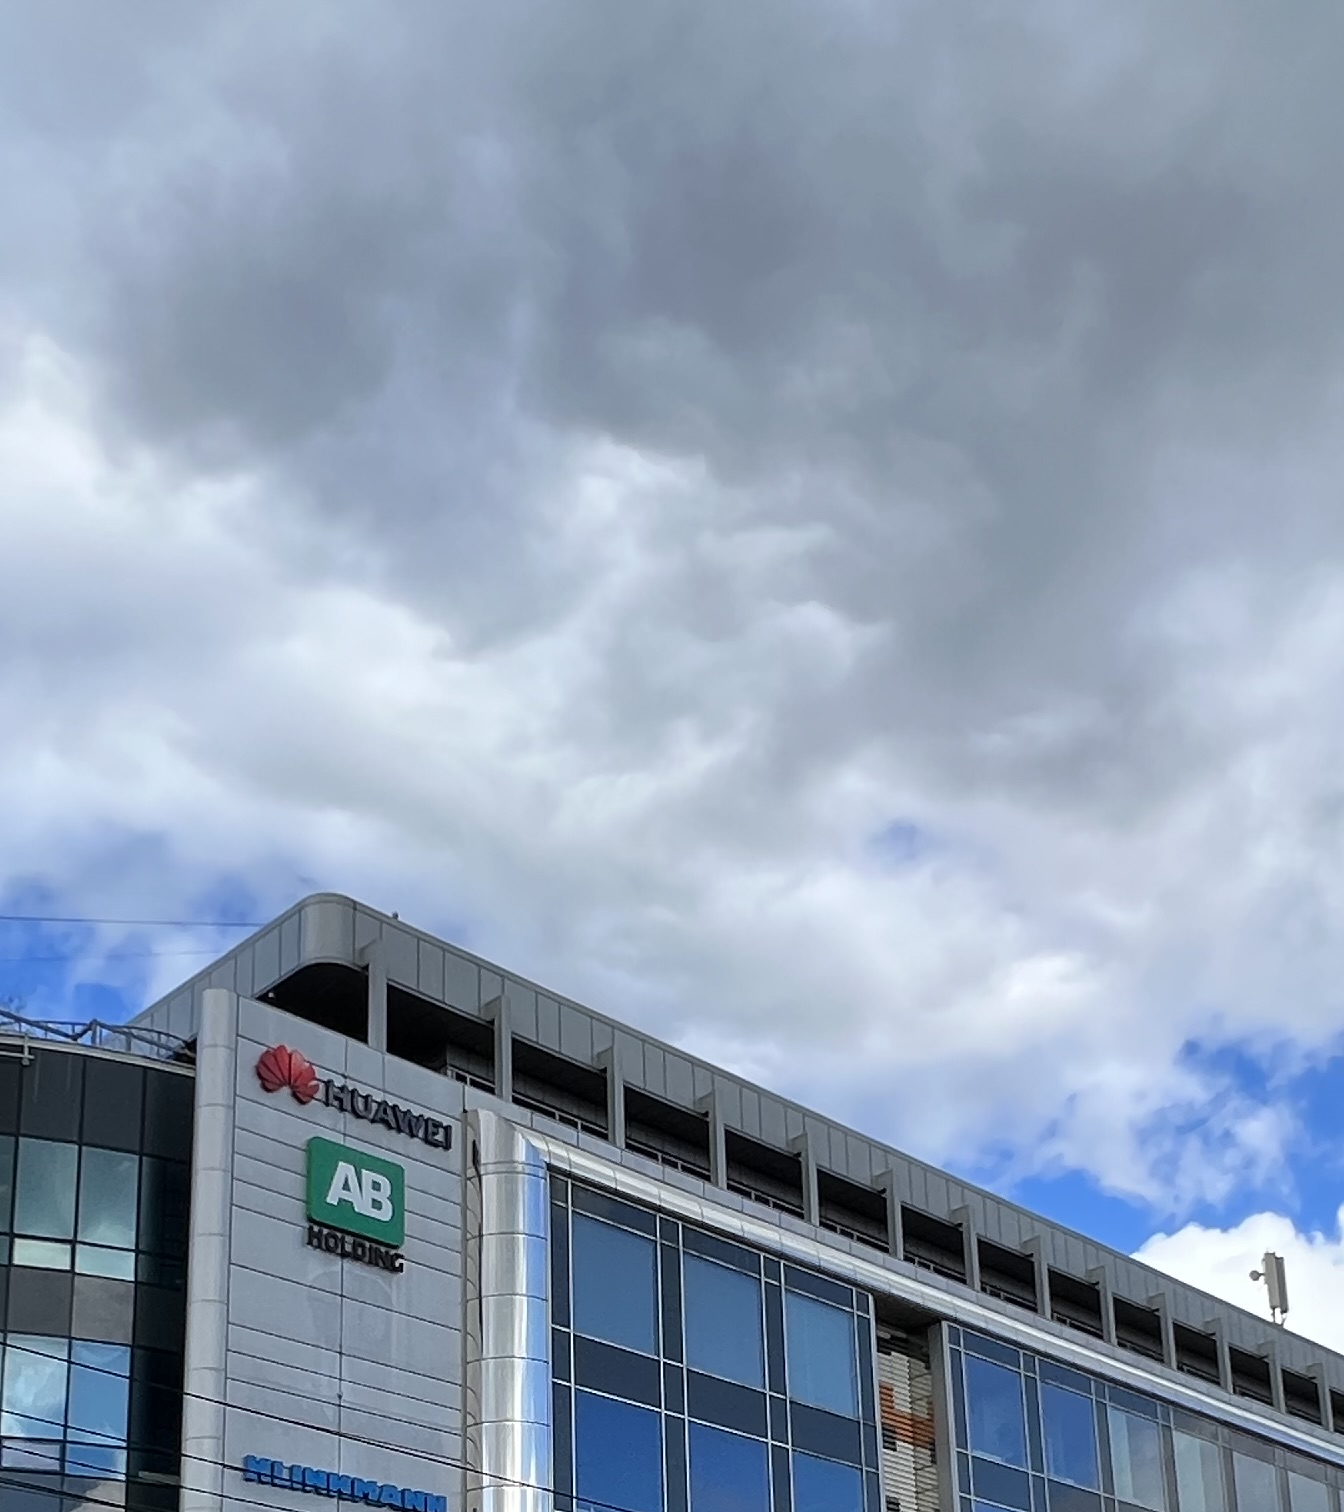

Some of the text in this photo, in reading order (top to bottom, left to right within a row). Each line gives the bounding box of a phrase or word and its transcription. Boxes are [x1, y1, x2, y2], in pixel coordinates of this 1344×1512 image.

[324, 1079, 452, 1151] HUAWEI
[326, 1161, 393, 1222] AB
[306, 1224, 404, 1274] HOLDING
